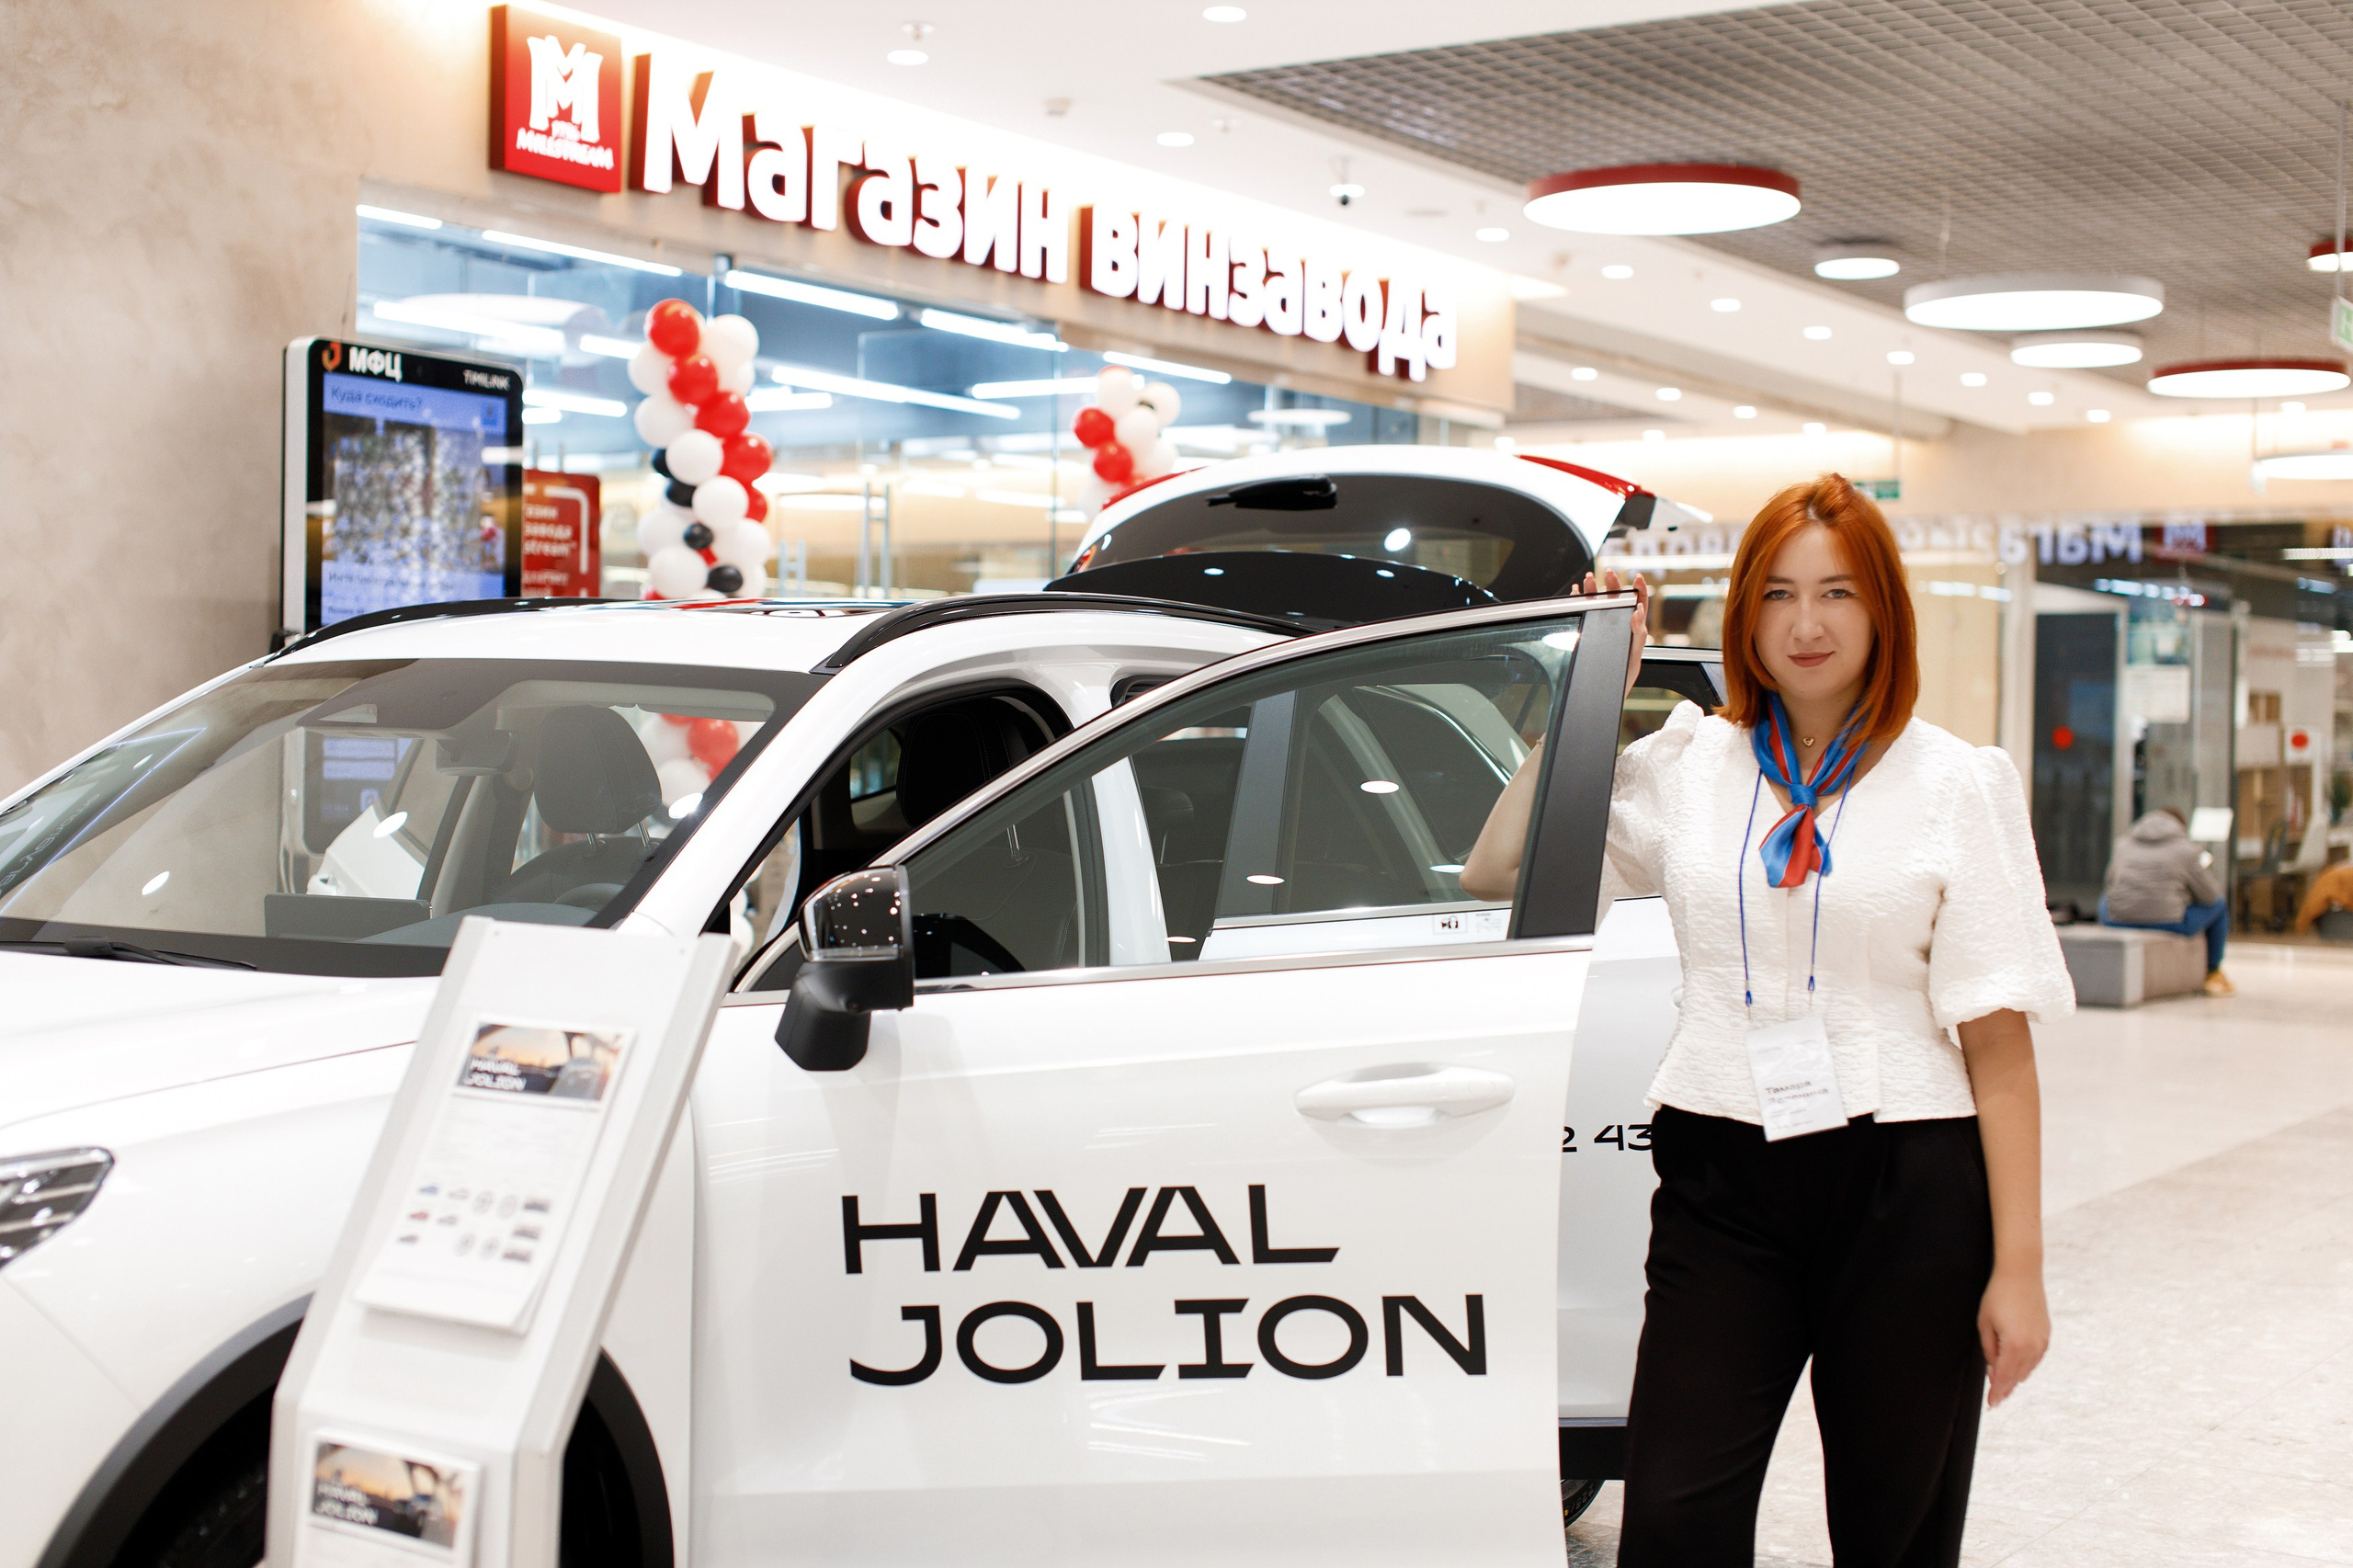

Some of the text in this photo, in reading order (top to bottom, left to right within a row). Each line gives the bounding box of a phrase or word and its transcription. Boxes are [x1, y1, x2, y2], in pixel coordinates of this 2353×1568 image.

[634, 52, 1458, 382] Магазин винзавода
[348, 347, 403, 382] МФЦ
[464, 1072, 527, 1092] JOLION
[841, 1184, 1340, 1275] HAVAL
[849, 1293, 1487, 1386] JOLION
